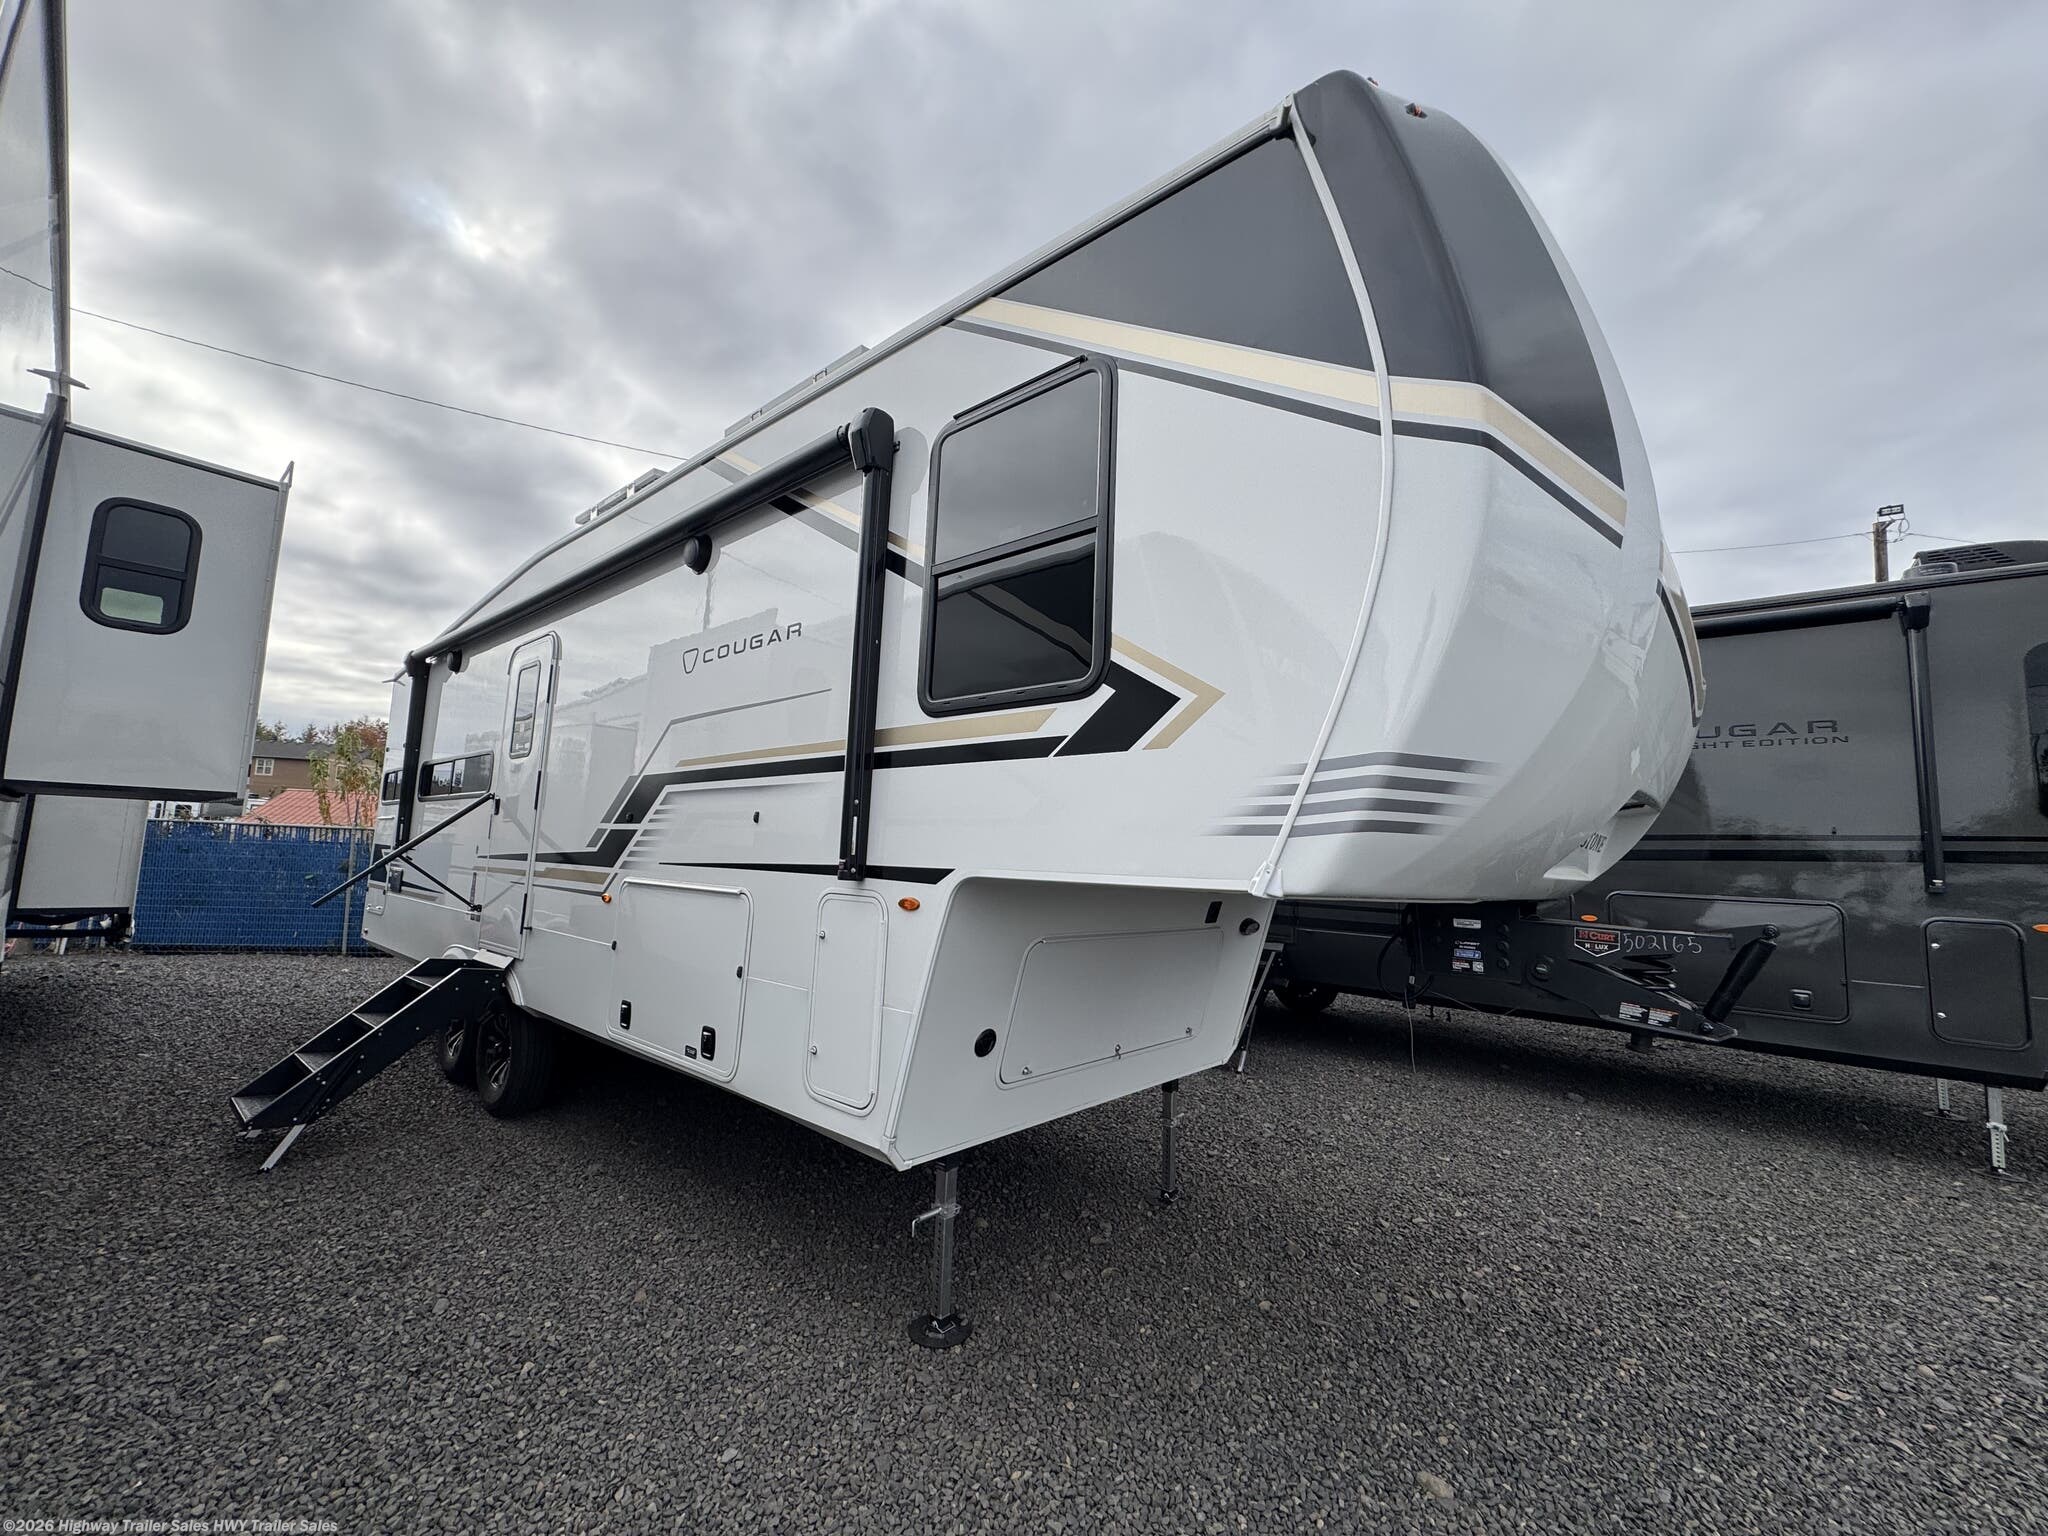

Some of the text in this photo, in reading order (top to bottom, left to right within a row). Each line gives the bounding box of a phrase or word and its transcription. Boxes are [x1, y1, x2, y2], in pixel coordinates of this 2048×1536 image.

[703, 622, 802, 663] COUGAR
[1742, 735, 1849, 749] EDITION
[1623, 932, 1702, 954] 502165
